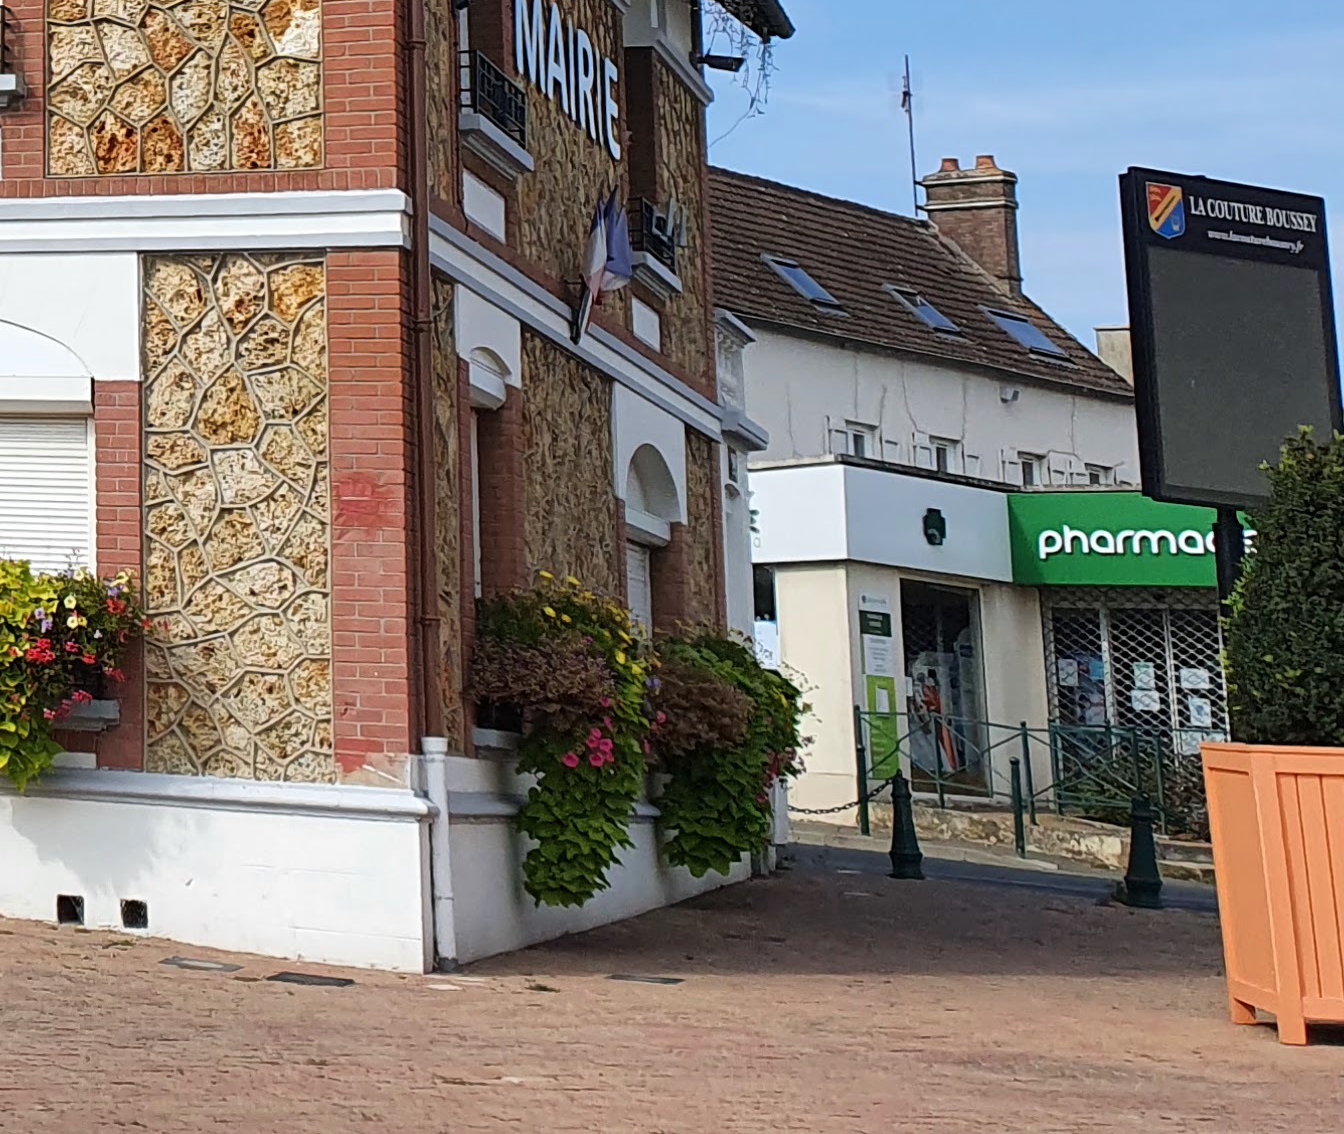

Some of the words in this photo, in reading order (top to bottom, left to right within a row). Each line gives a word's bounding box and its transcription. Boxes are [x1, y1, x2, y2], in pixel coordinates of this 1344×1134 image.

[1189, 196, 1206, 216] LA
[1207, 199, 1265, 224] COUTURE
[1265, 207, 1317, 232] BOUSSEY
